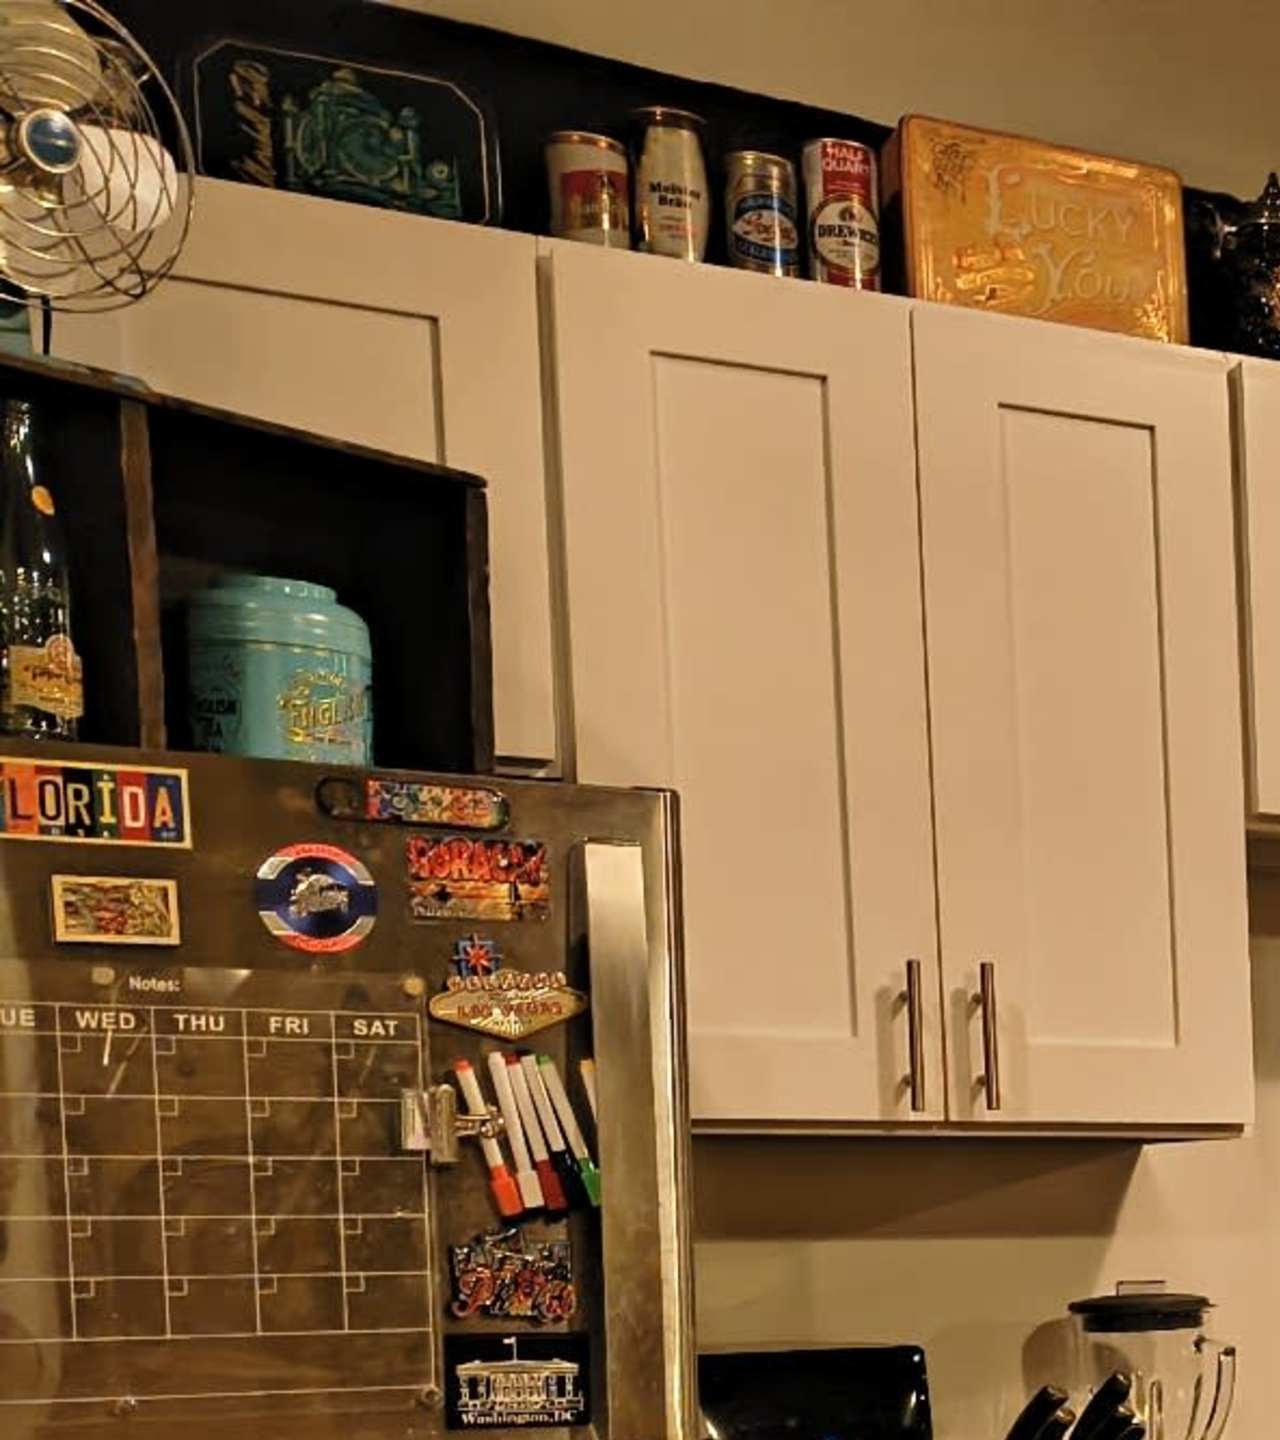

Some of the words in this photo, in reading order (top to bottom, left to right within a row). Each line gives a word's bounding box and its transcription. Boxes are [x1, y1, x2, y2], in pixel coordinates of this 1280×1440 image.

[825, 144, 864, 157] HALF
[822, 159, 870, 175] QUART
[0, 770, 176, 829] LORIDA
[129, 976, 181, 993] Notes:
[0, 1009, 36, 1028] UE
[75, 1012, 136, 1030] WED
[173, 1014, 225, 1032] THU
[270, 1017, 309, 1034] FRI
[353, 1020, 398, 1036] SAT
